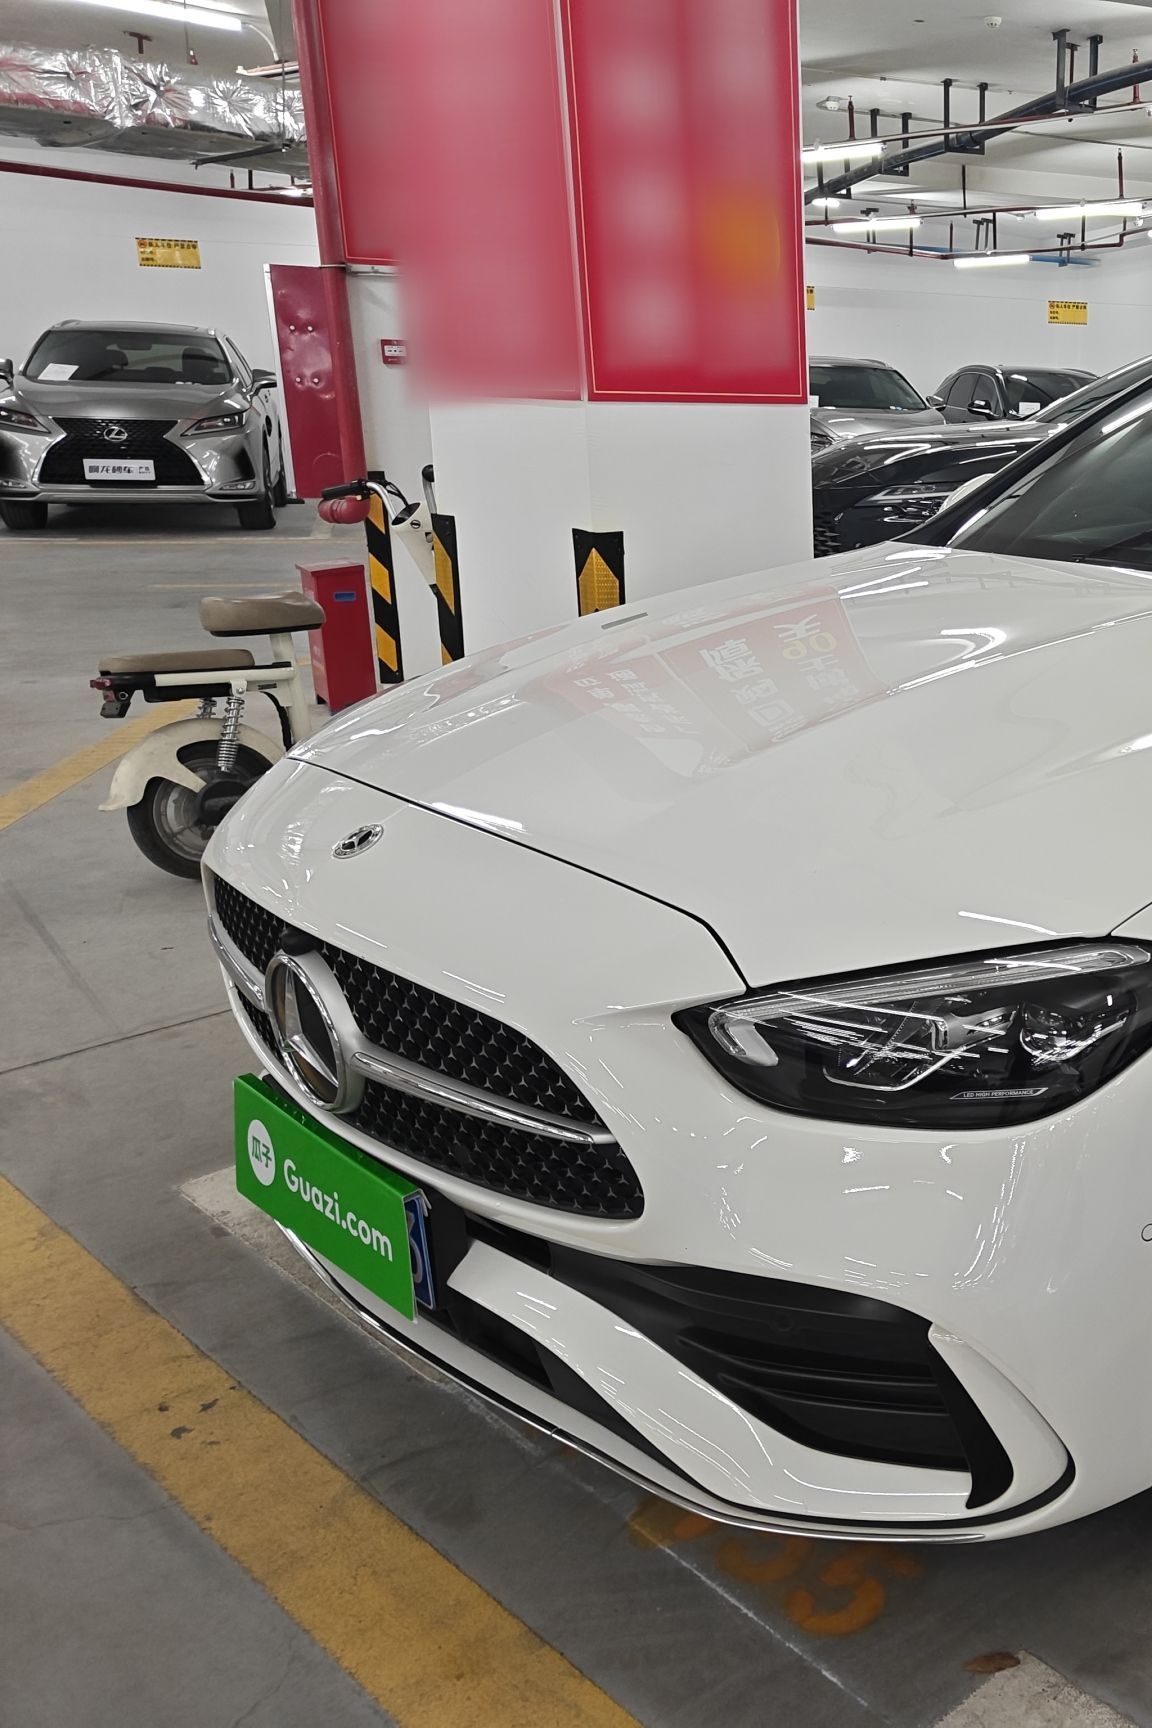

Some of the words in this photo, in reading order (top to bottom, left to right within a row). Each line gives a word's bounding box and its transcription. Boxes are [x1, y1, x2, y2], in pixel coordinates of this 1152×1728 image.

[991, 1089, 1034, 1097] PERFORMANCE
[251, 1135, 273, 1168] 瓜子
[283, 1158, 393, 1262] Guazi.com
